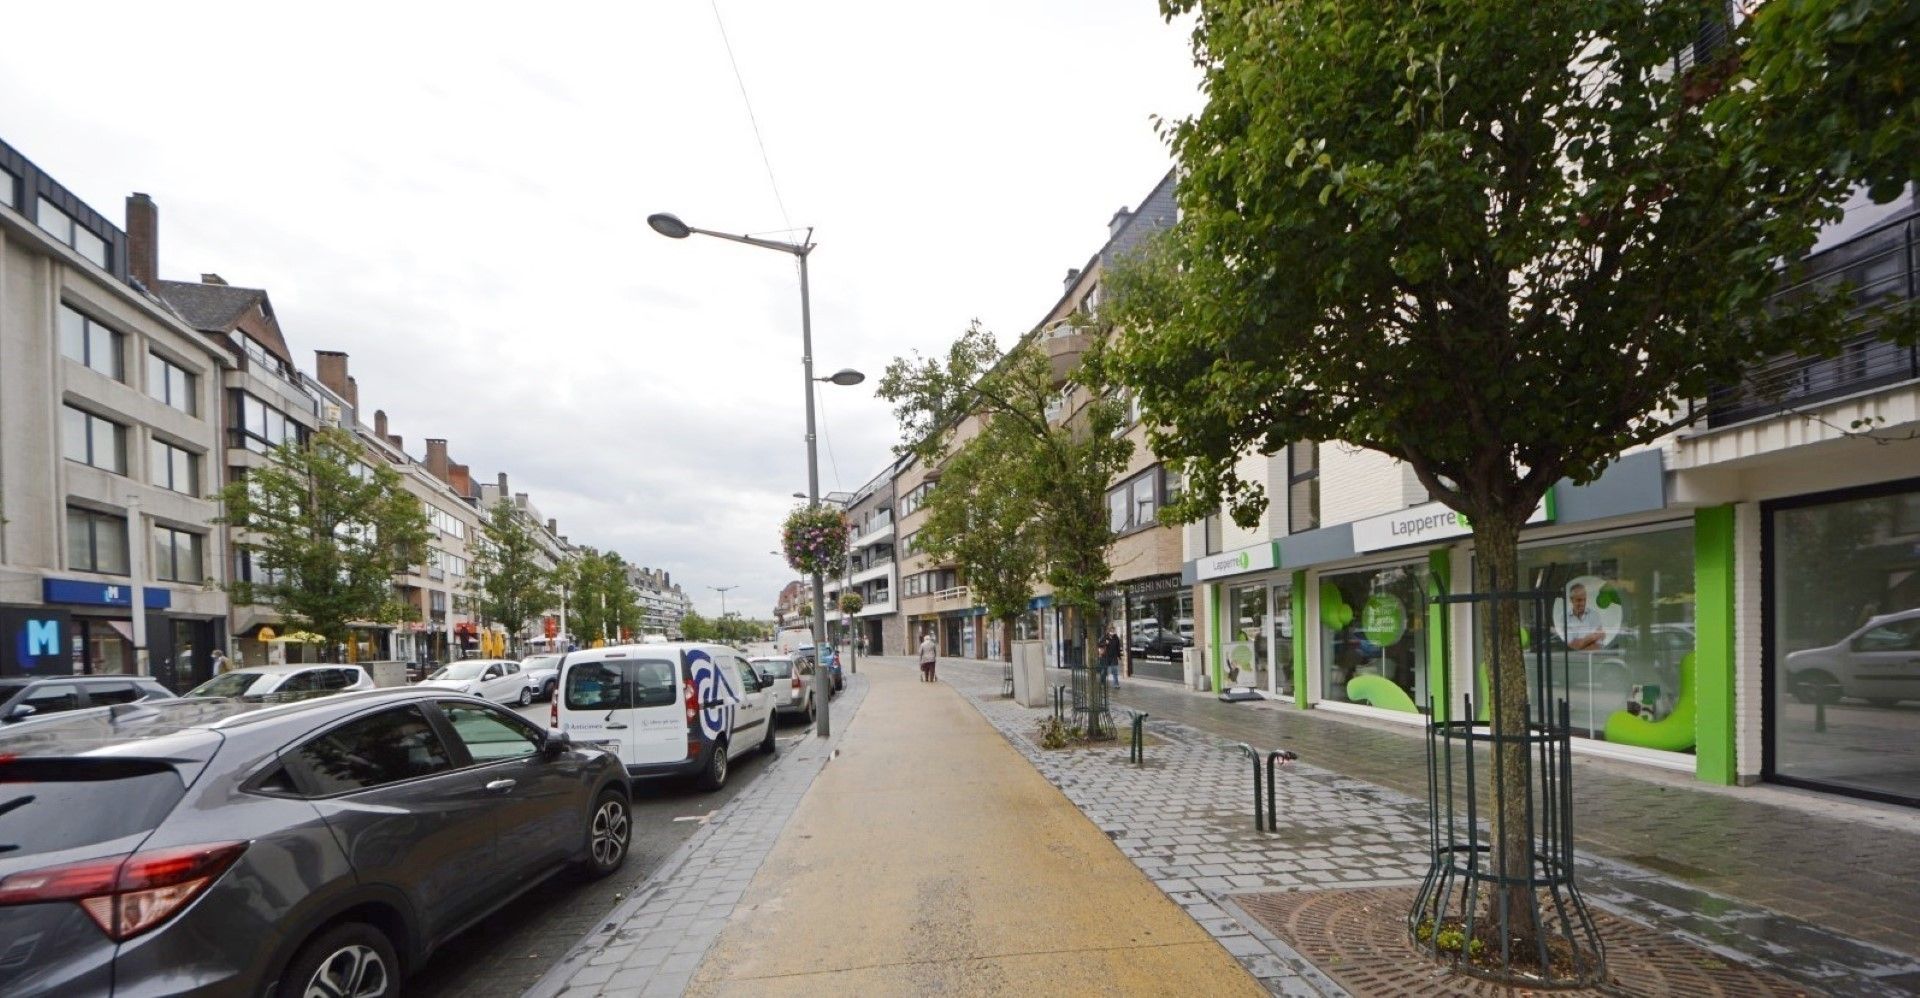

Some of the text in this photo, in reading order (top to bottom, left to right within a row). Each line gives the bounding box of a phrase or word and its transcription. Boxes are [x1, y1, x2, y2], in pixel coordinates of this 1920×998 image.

[1391, 511, 1456, 536] Lapperre
[1213, 557, 1239, 572] Lapperre
[1129, 581, 1154, 593] SUSHI
[28, 619, 60, 656] M
